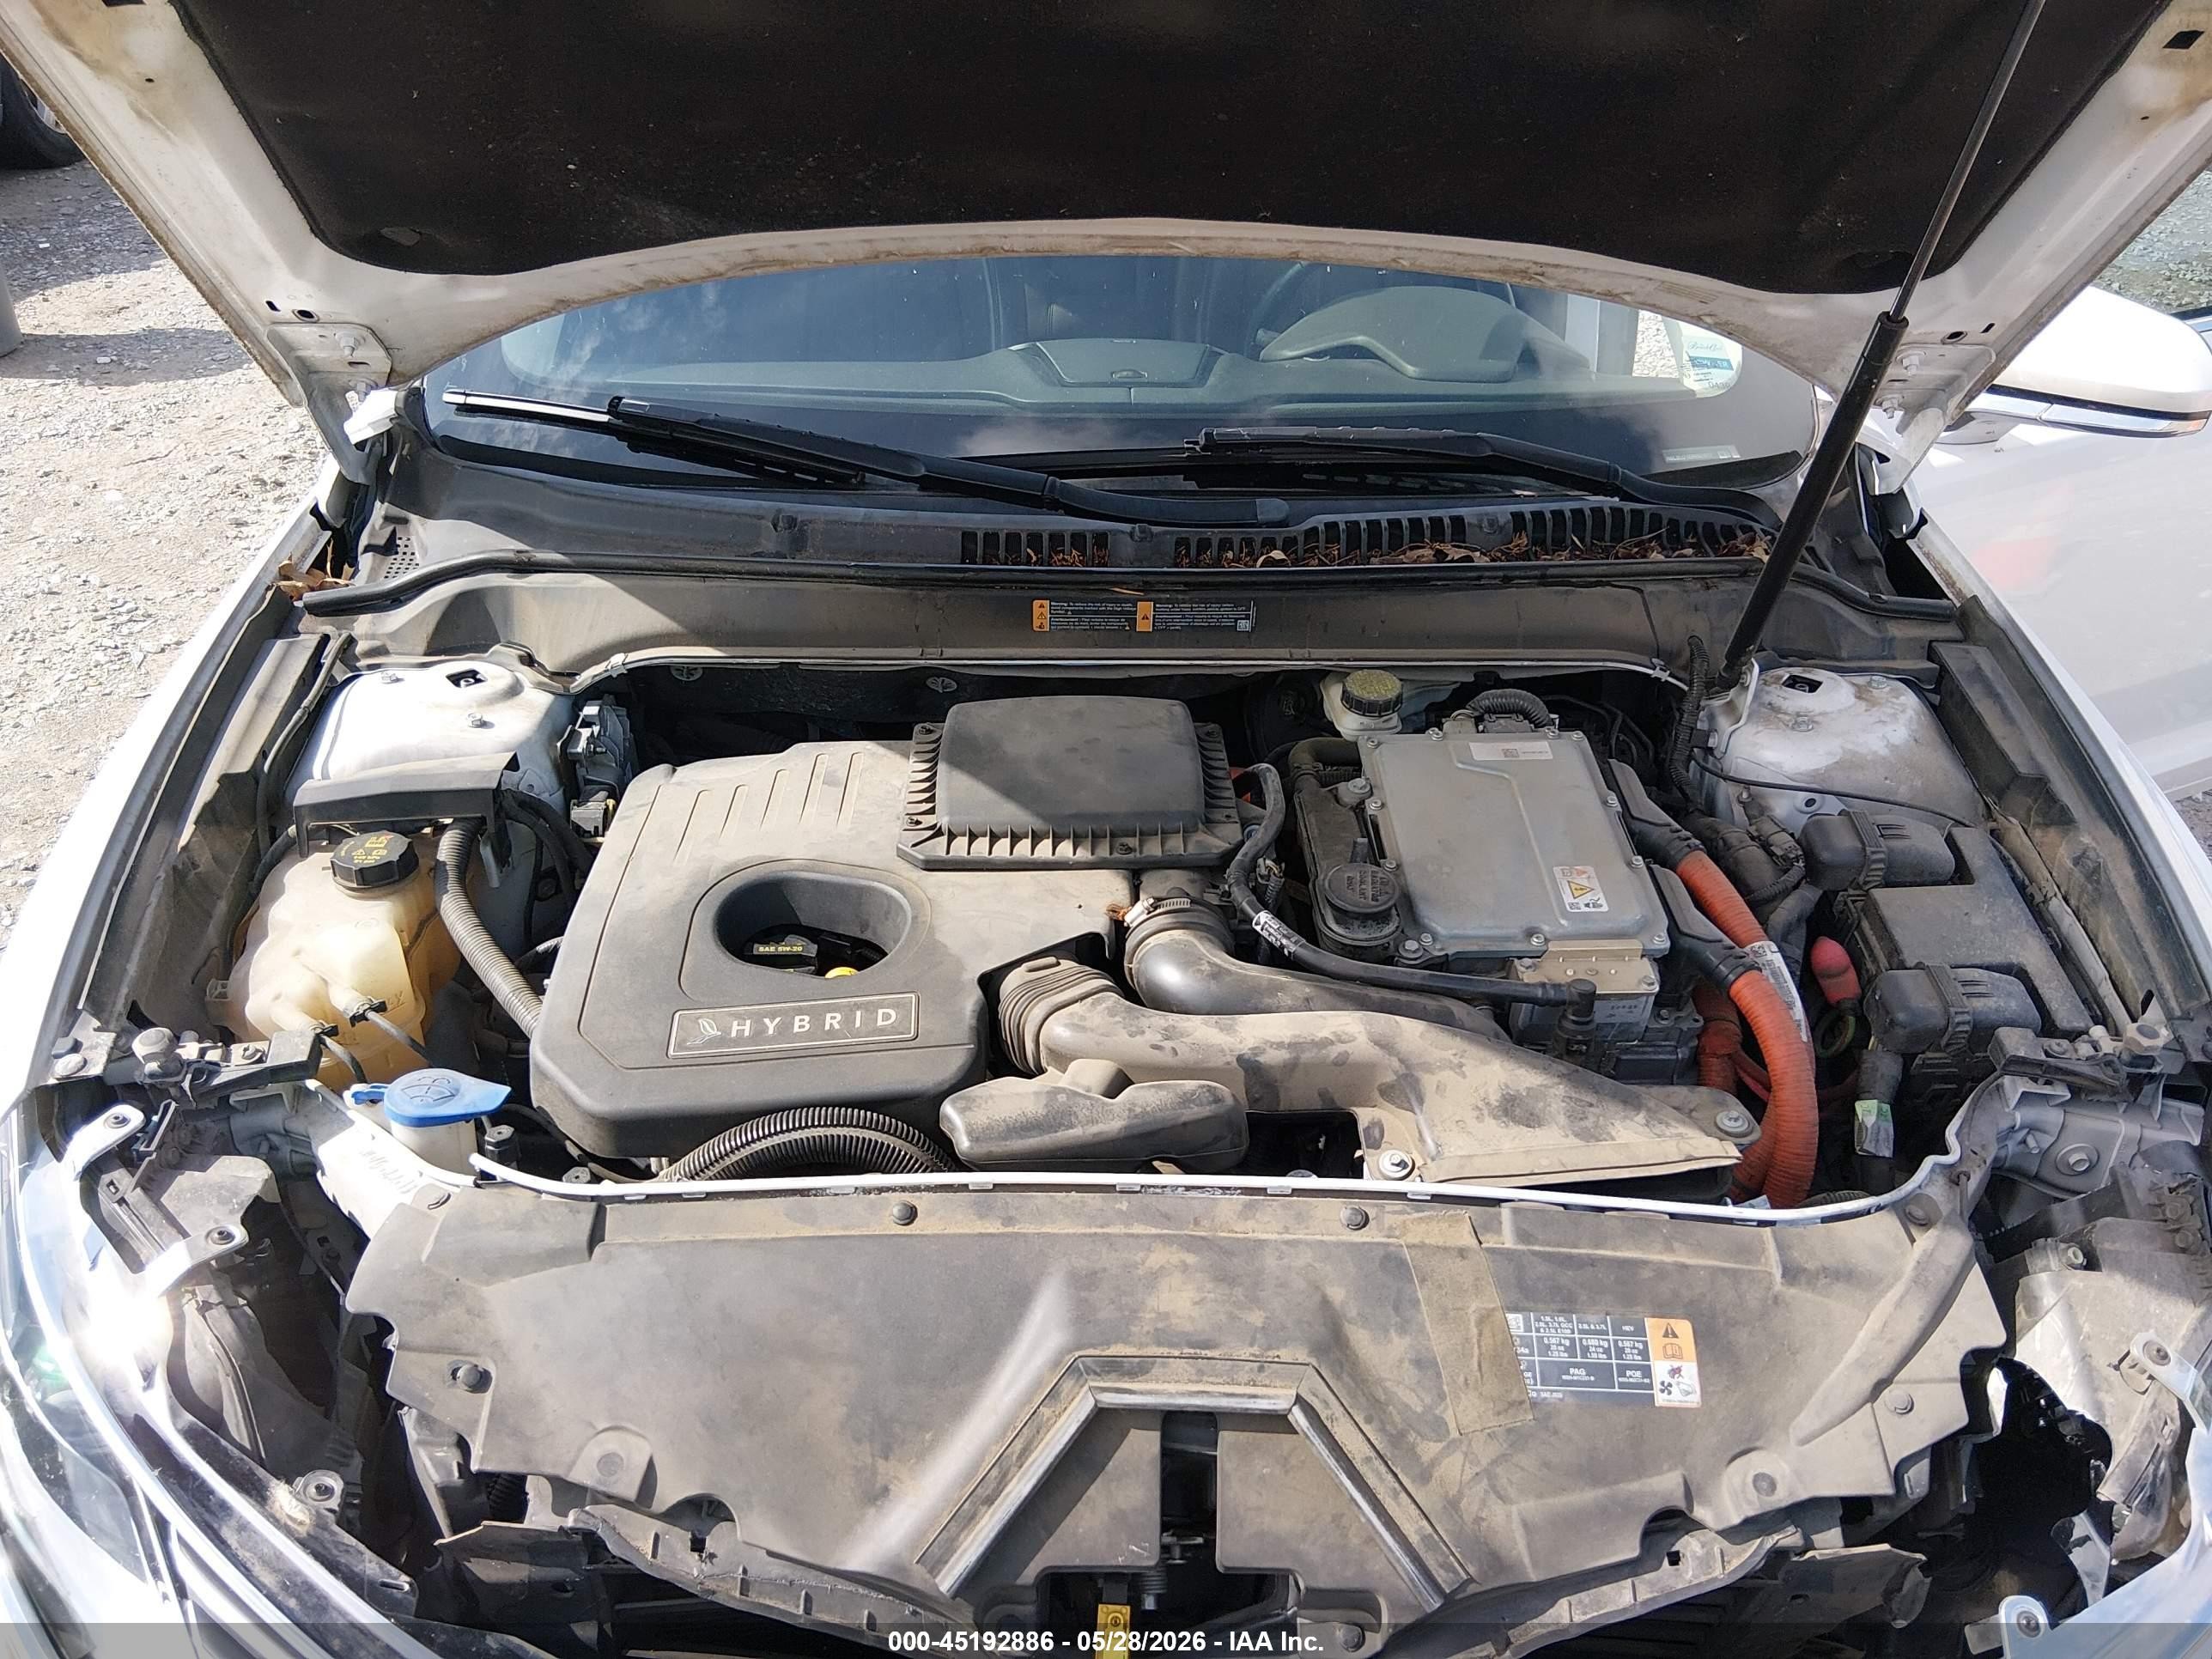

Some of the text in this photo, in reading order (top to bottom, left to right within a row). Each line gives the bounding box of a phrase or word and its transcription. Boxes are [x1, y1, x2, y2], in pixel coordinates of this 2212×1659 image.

[731, 1008, 896, 1037] HYBRID
[1561, 1337, 1570, 1346] kg
[1599, 1339, 1608, 1348] kg
[1635, 1340, 1644, 1350] kg
[1569, 1367, 1586, 1376] PAG
[1626, 1370, 1642, 1378] POE
